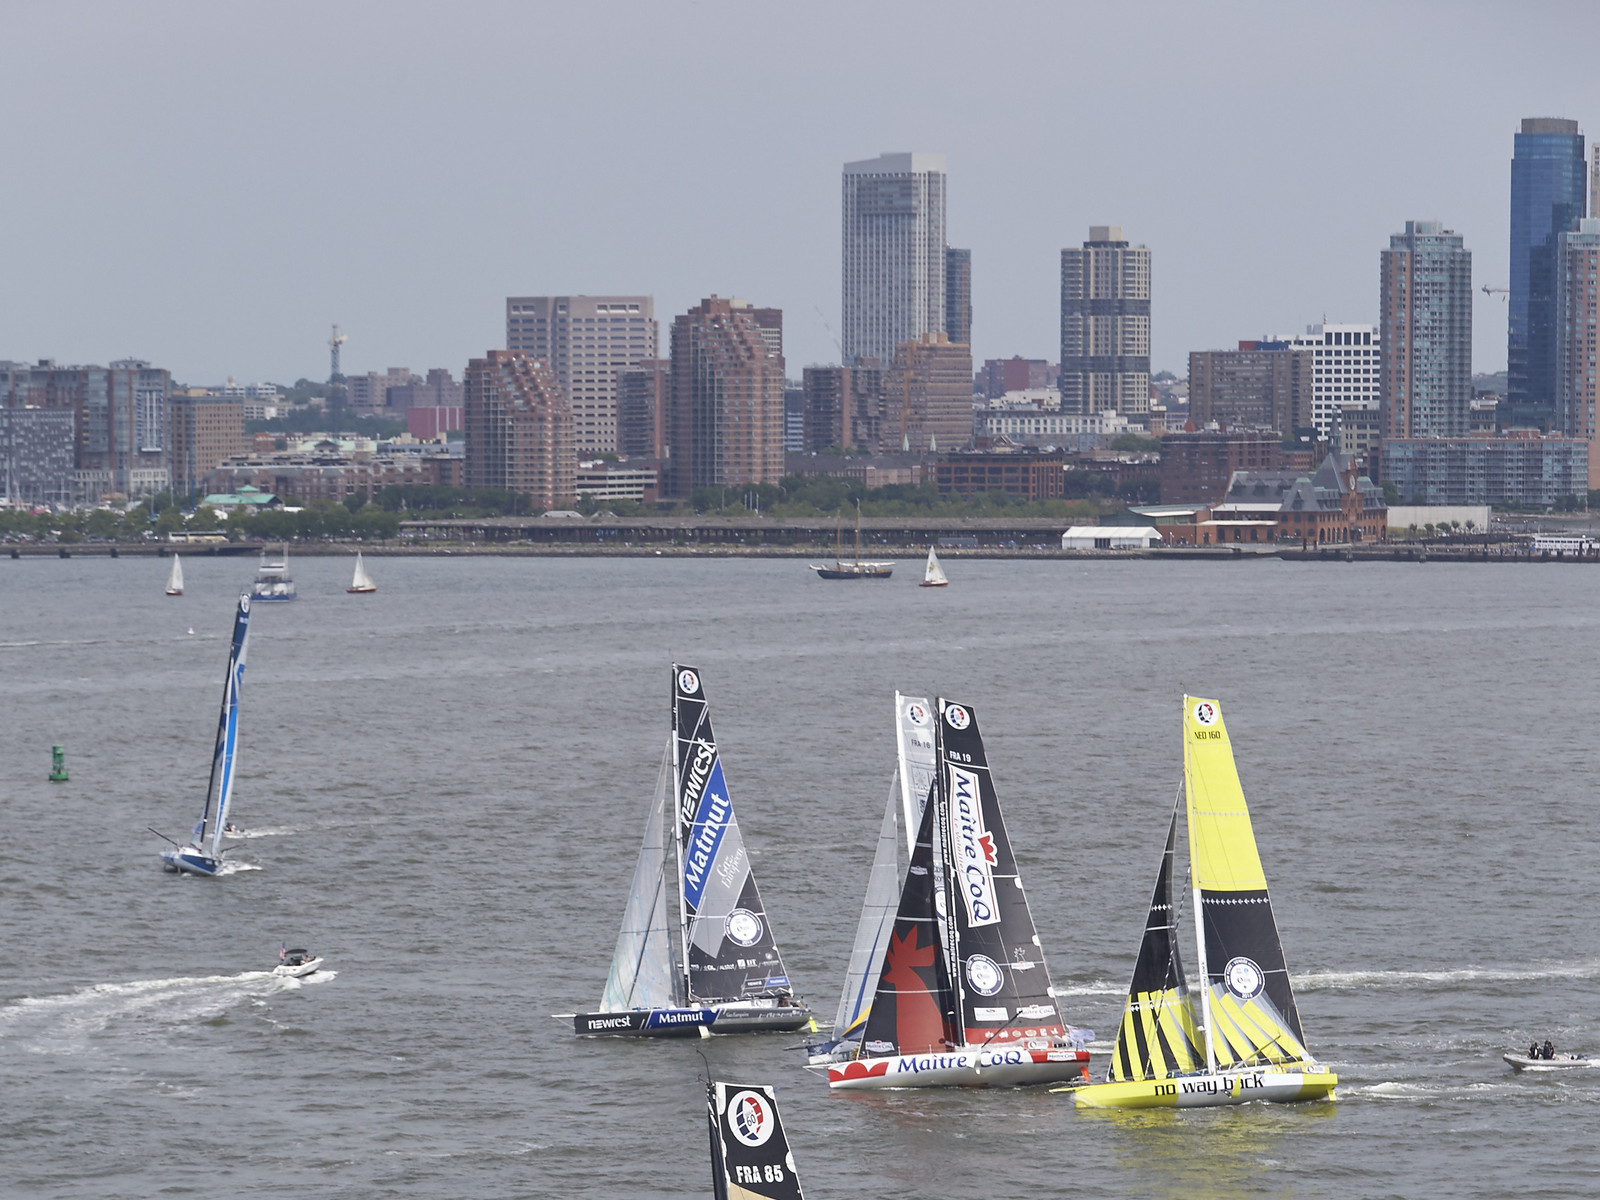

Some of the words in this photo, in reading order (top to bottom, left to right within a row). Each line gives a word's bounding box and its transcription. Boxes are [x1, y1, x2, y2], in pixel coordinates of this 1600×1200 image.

[1208, 730, 1221, 740] 160
[949, 751, 961, 761] FRA
[962, 753, 971, 762] 19
[680, 736, 716, 829] newrest
[685, 792, 729, 891] Matmut
[956, 772, 976, 860] Maître
[966, 864, 991, 923] CoQ
[588, 1015, 632, 1030] newrest
[658, 1010, 704, 1025] Matmut
[898, 1053, 967, 1074] Maître
[980, 1050, 1024, 1068] CoQ
[1154, 1083, 1176, 1096] no
[1182, 1079, 1218, 1095] way
[746, 1113, 757, 1127] 60
[735, 1165, 762, 1183] FRA
[763, 1164, 784, 1183] 85
